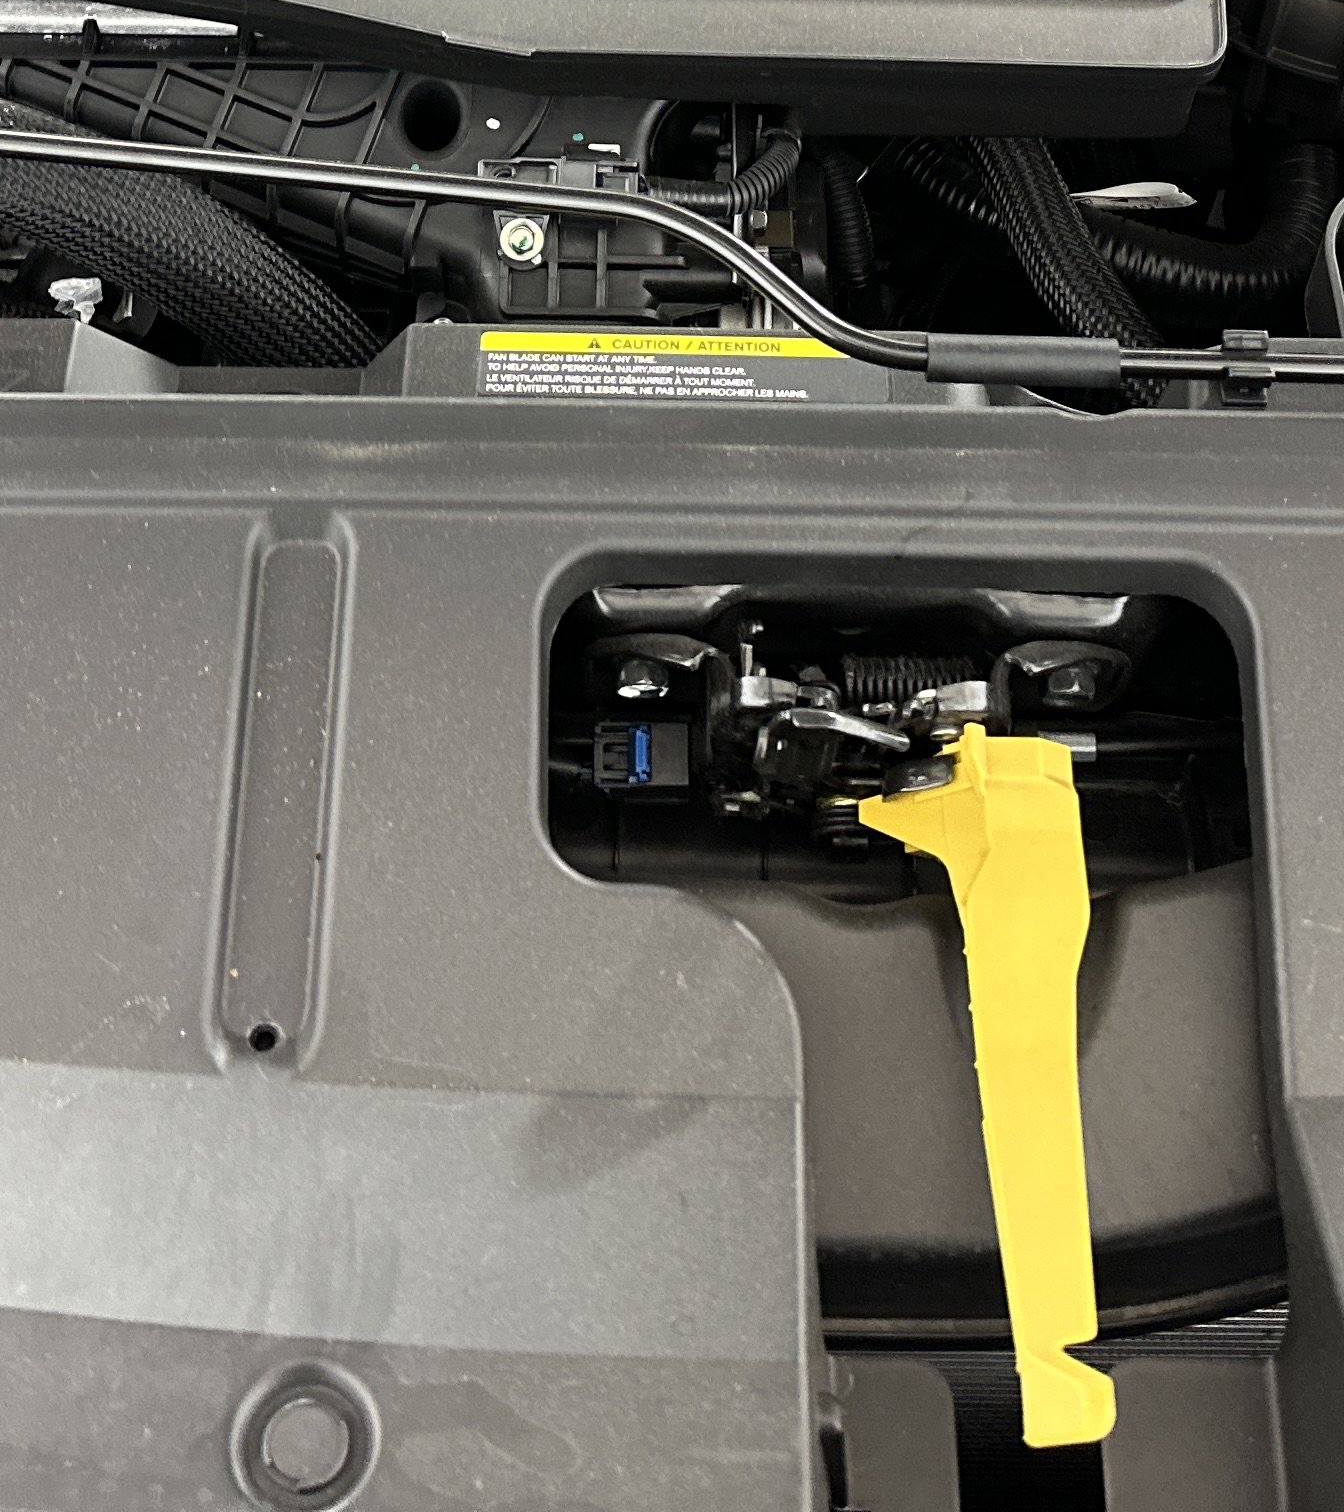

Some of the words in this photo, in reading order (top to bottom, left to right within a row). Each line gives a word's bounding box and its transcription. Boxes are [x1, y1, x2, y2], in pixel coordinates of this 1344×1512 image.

[612, 338, 680, 351] CAUTION
[697, 340, 782, 352] ATTENTION
[487, 352, 507, 361] FAN
[508, 353, 541, 361] BLADE
[542, 353, 564, 362] CAN
[566, 354, 596, 363] START
[597, 354, 609, 363] AT
[611, 355, 631, 363] ANY
[487, 362, 501, 371] TO
[502, 363, 529, 372] HELP
[529, 363, 560, 372] AVOID
[561, 364, 613, 373] PERSONAL
[676, 366, 711, 375] HANDS
[712, 366, 746, 376] CLEAR.
[486, 373, 499, 382] LE
[500, 373, 563, 383] VENTILATEUR
[564, 374, 602, 384] RISQUE
[603, 375, 617, 384] DE
[618, 374, 673, 385] DÉMARRER
[674, 374, 682, 385] À
[683, 377, 709, 386] TOUT
[485, 383, 515, 392] POUR
[516, 382, 549, 393] ÉVITER
[550, 384, 583, 394] TOUTE
[639, 386, 654, 395] NE
[654, 386, 675, 396] PAS
[676, 387, 691, 396] EN
[691, 387, 754, 397] APPROCHER
[754, 388, 774, 398] LES
